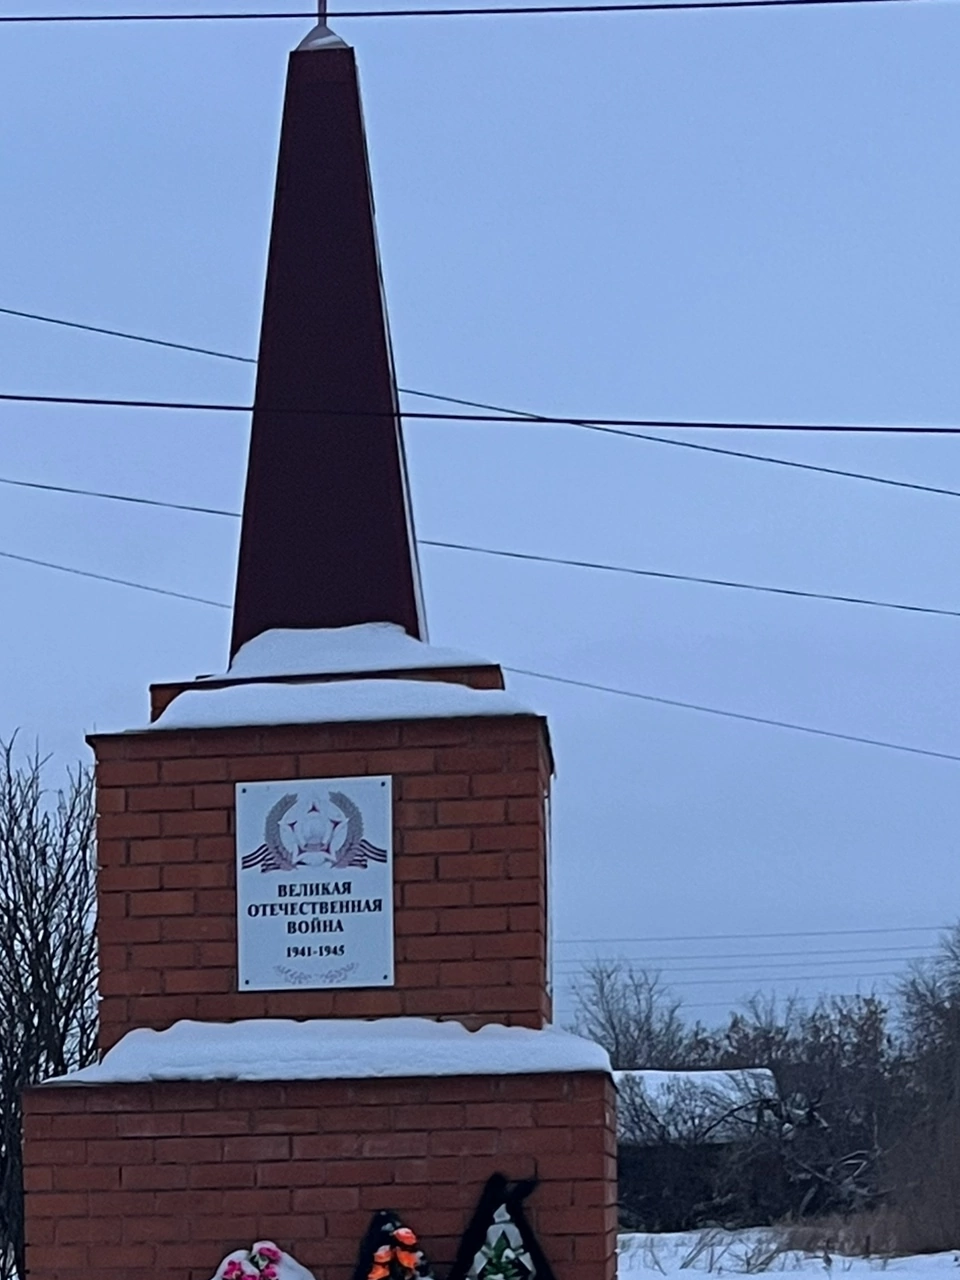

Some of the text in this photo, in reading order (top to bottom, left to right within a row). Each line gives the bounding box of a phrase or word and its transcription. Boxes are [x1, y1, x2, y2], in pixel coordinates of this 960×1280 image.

[278, 881, 352, 897] ВЕЛИКАЯ
[247, 898, 383, 917] ОТЕЧЕСТВЕННАЯ
[287, 917, 344, 934] ВОЙНА
[287, 945, 345, 958] 1941-1945
